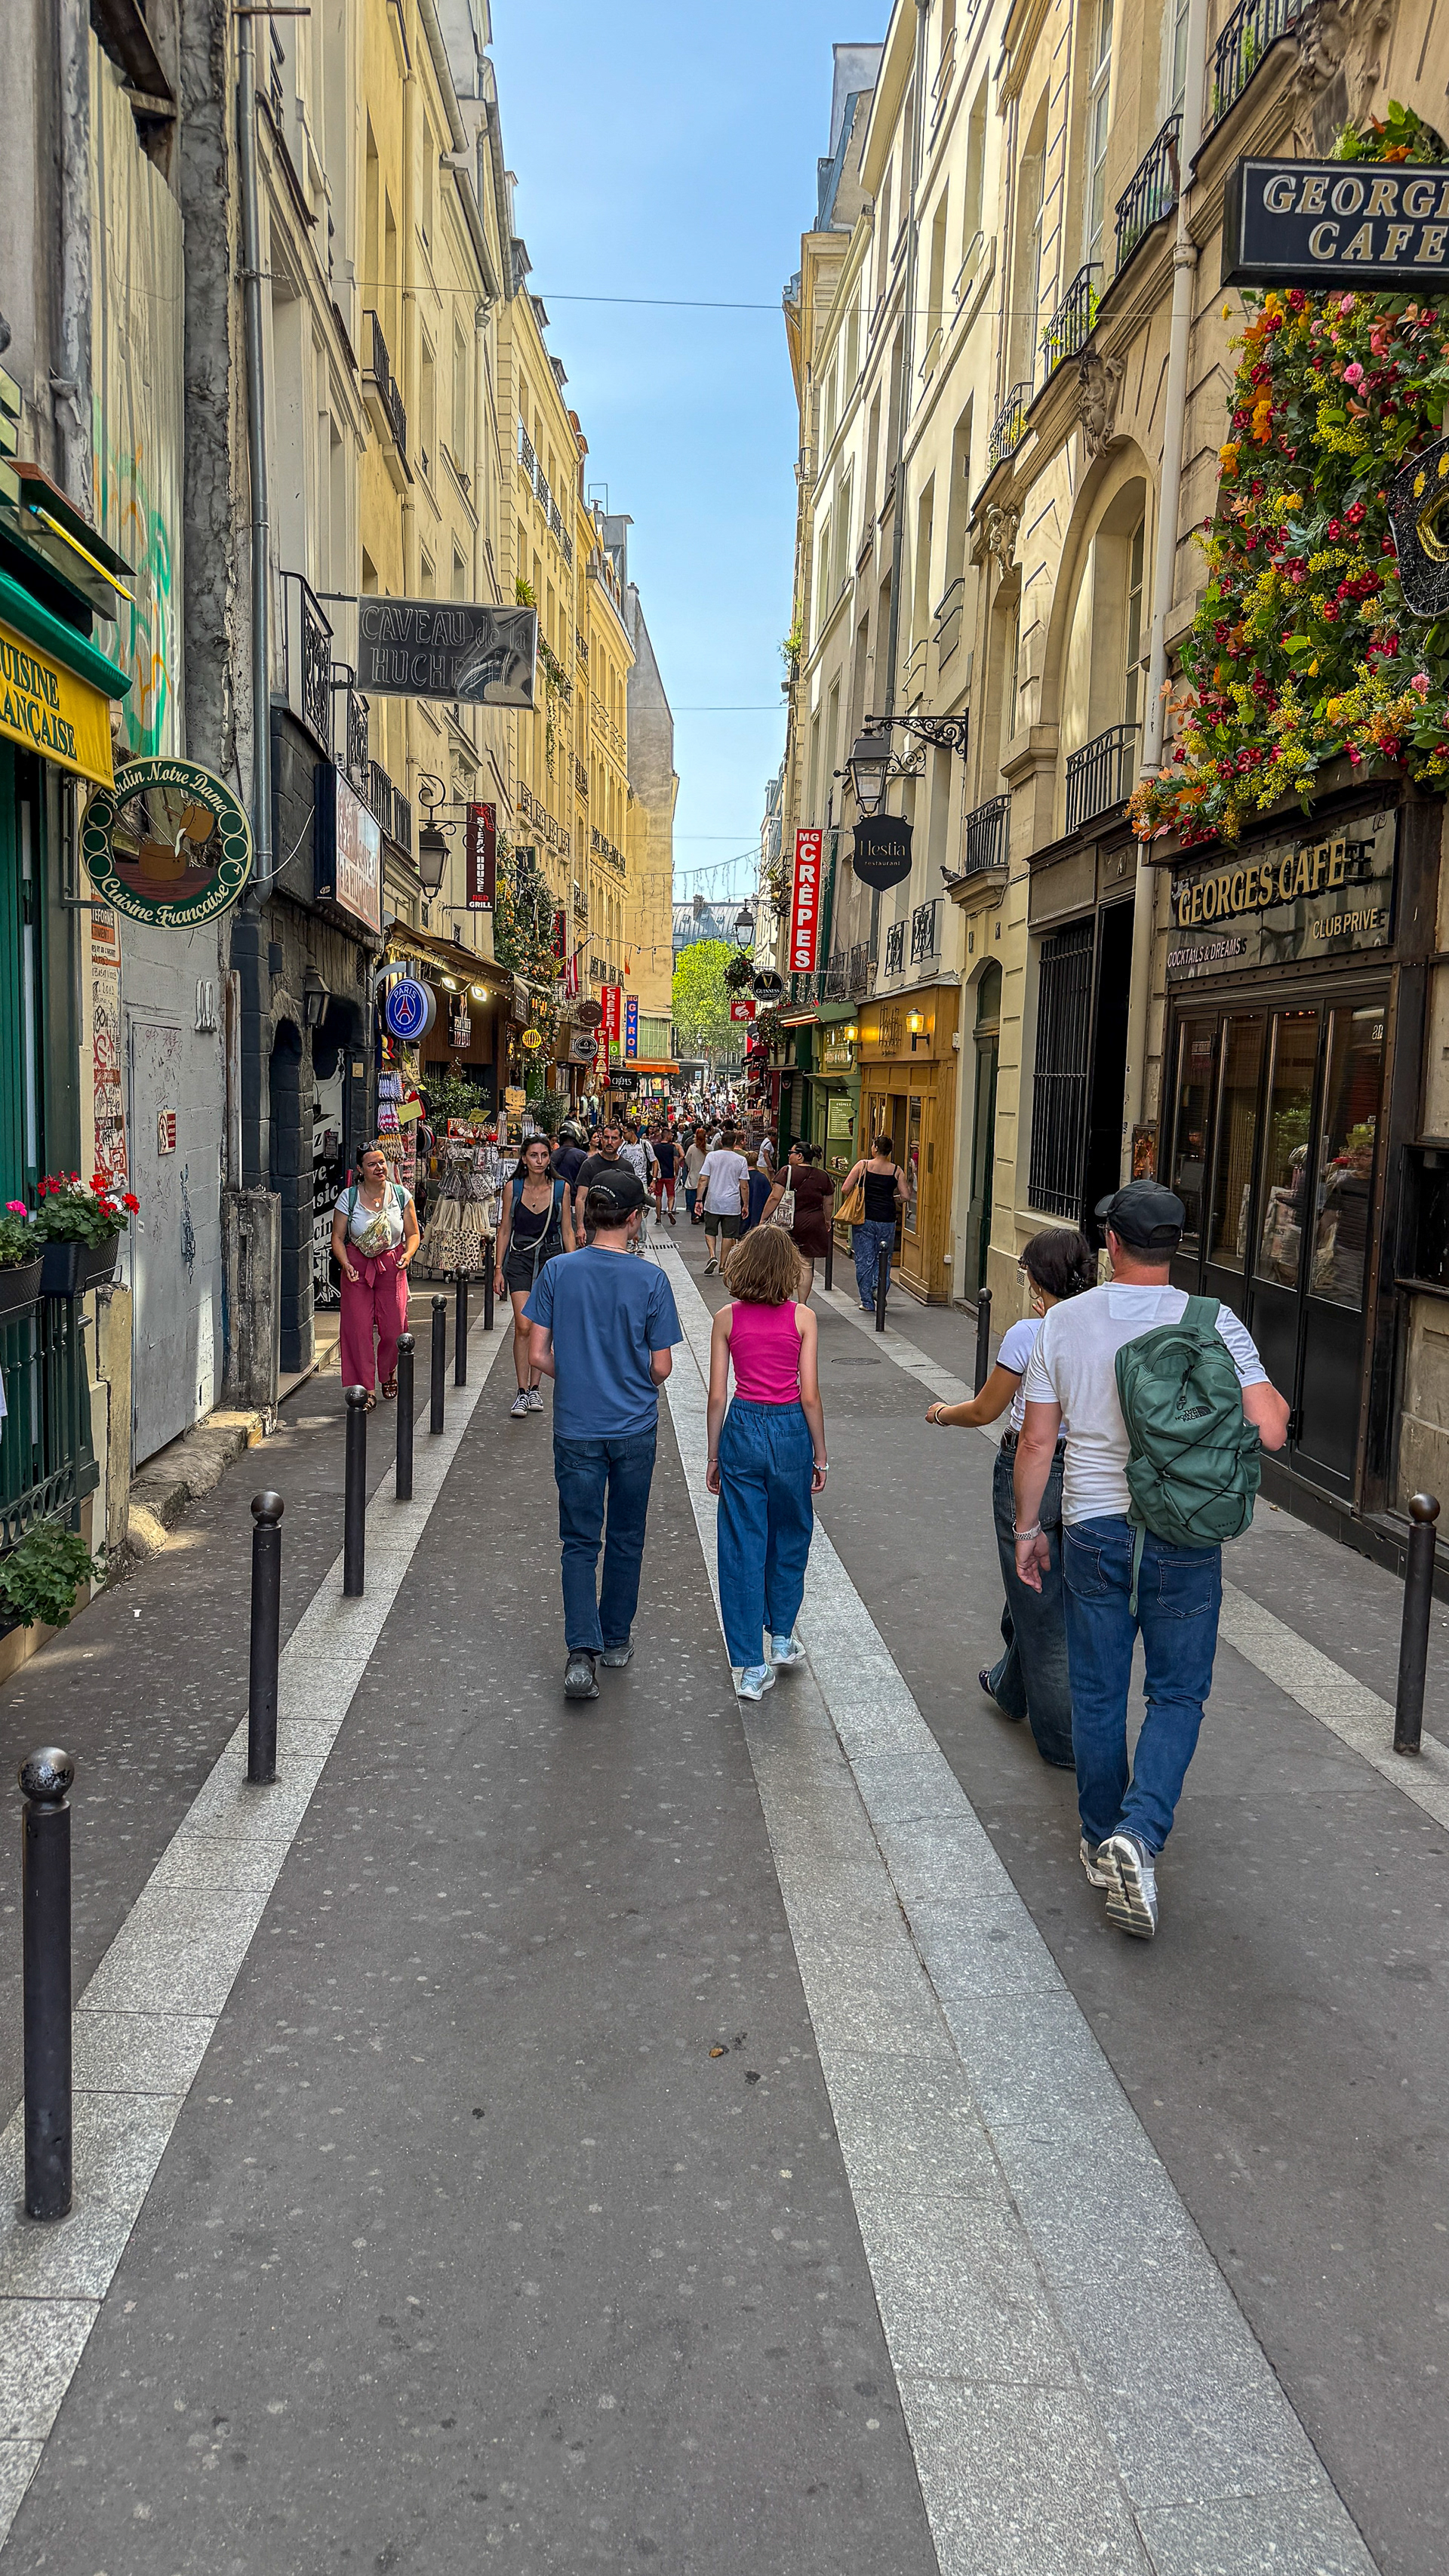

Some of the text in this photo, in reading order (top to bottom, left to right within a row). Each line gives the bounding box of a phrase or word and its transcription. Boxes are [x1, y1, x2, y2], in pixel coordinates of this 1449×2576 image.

[1308, 221, 1448, 263] CAFE
[361, 605, 466, 647] CAVEAU
[0, 640, 60, 711] UISINE
[0, 685, 77, 762] ANÇAISE
[147, 762, 189, 784] Notre
[189, 774, 227, 813] Dame
[798, 833, 820, 842] MG
[860, 840, 906, 856] Hestia
[476, 856, 485, 893] HOUSE
[1179, 837, 1346, 926] GEORGES CAFE
[102, 878, 229, 928] Cuisine Française
[795, 843, 817, 968] CRÊPES
[1313, 907, 1378, 939] CLUB PRIVE
[1168, 937, 1241, 968] COCKTAILS & DREAMS
[393, 986, 417, 999] PARIS
[627, 1003, 636, 1057] GYROS
